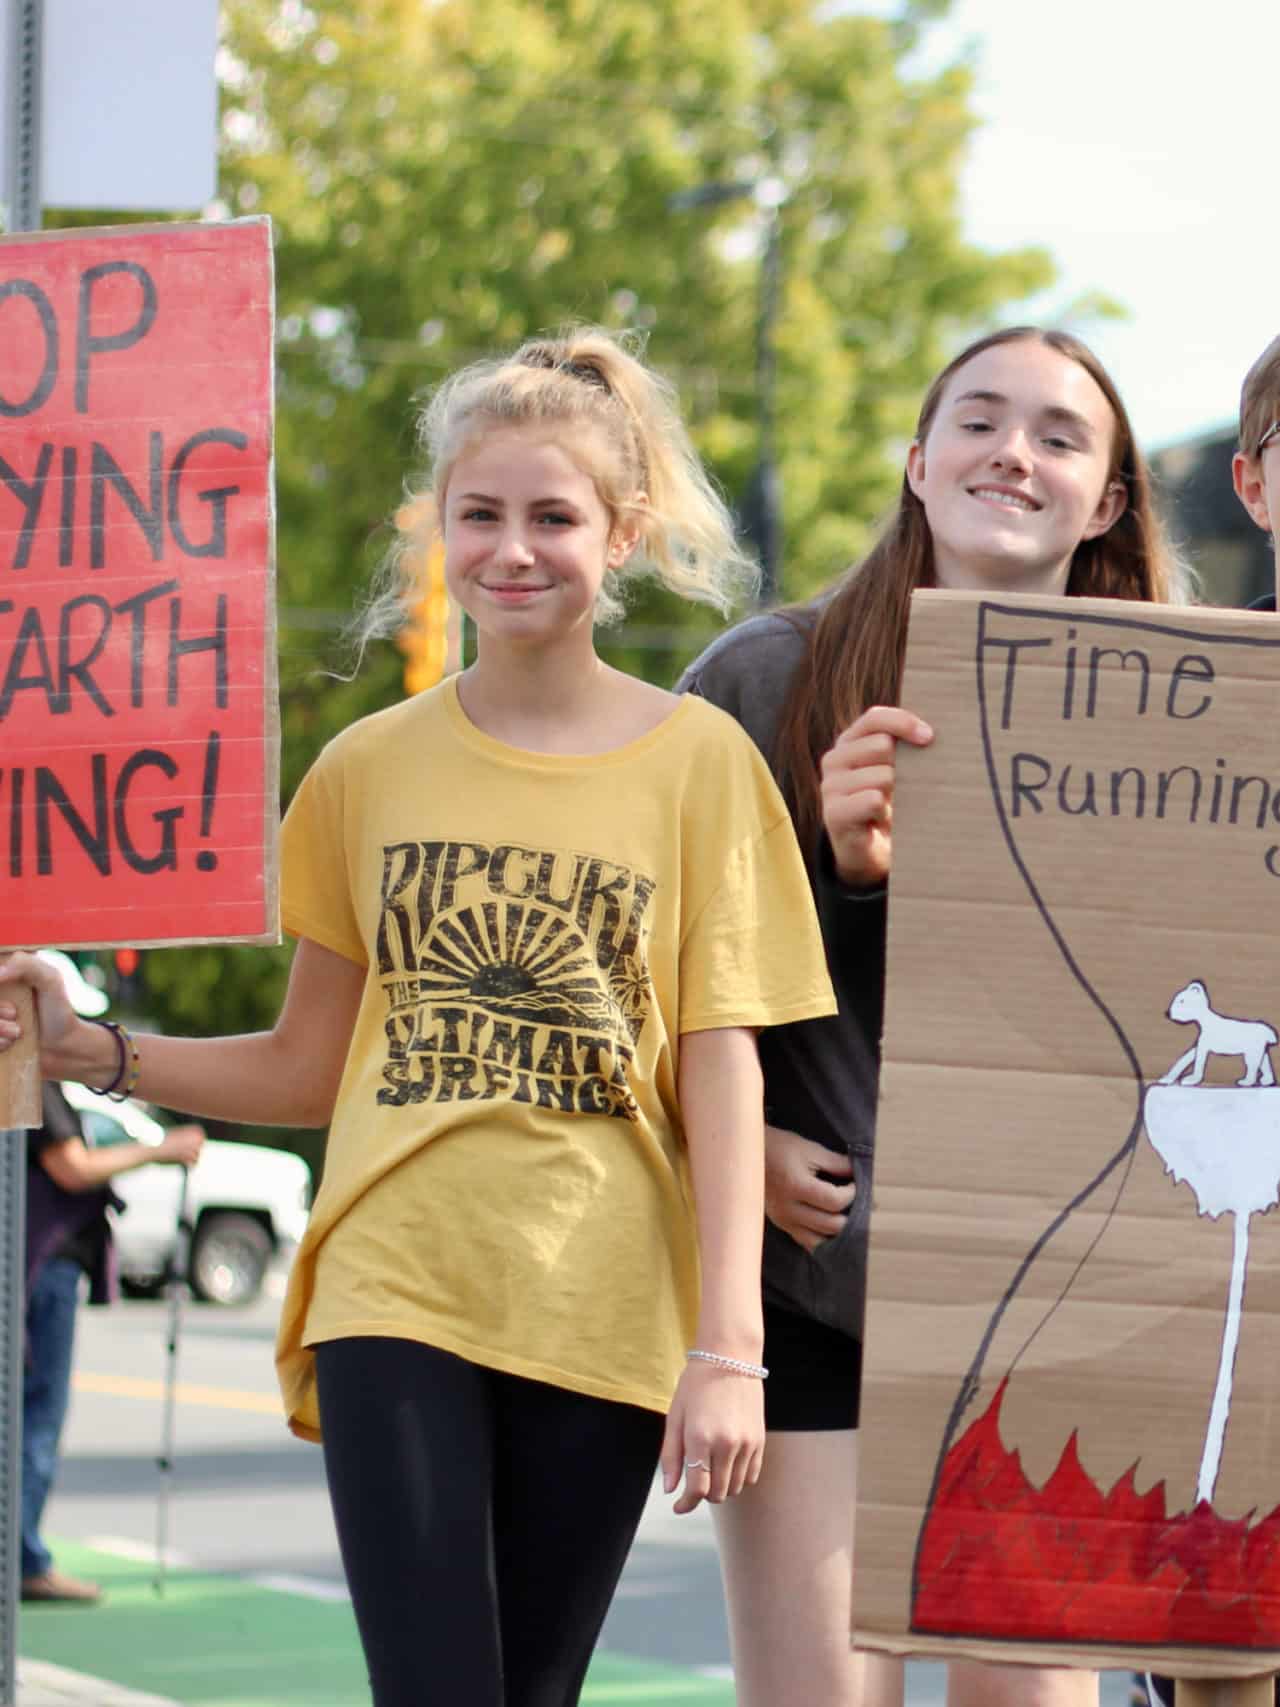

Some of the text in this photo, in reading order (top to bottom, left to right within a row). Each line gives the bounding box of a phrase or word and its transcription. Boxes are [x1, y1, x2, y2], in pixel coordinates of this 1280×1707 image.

[0, 579, 229, 722] ARTH
[984, 629, 1214, 730] Time
[0, 730, 220, 877] ING!
